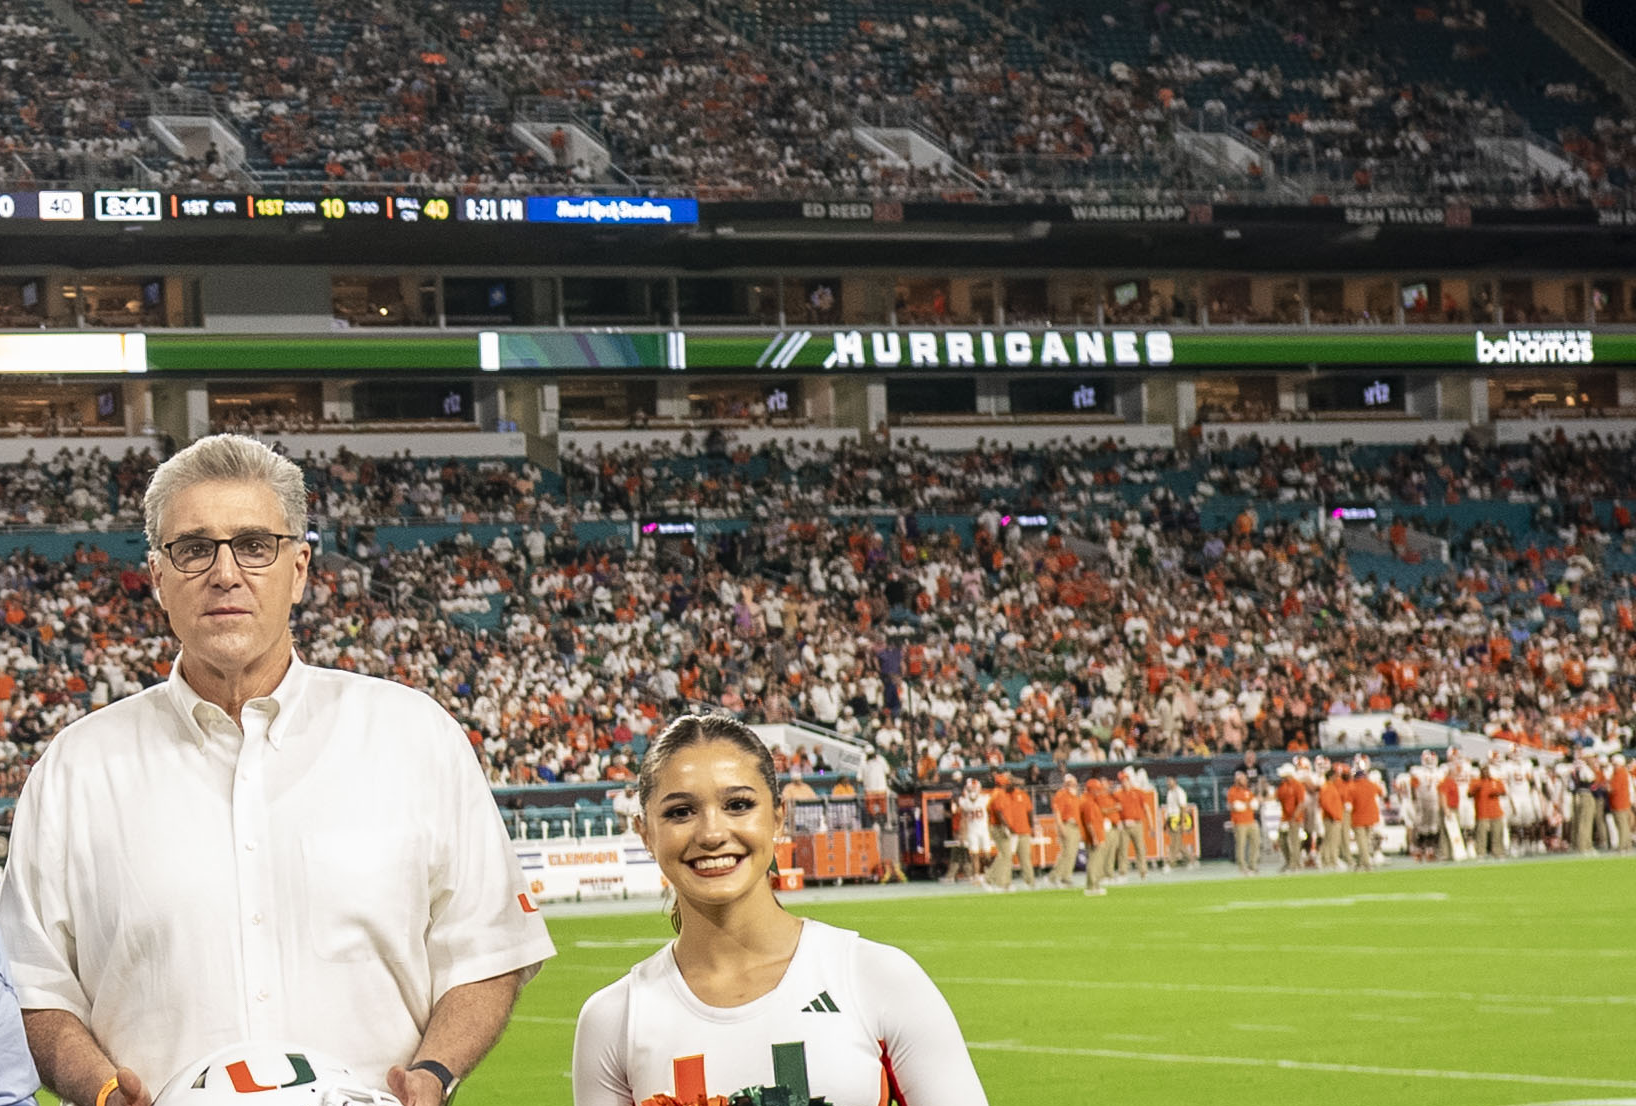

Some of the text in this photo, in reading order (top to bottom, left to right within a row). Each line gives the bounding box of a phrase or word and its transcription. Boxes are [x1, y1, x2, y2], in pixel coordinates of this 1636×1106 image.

[49, 198, 72, 214] 40
[105, 196, 151, 216] 8:44
[182, 199, 209, 216] 1ST
[256, 199, 285, 216] 1ST
[320, 198, 345, 219] 10
[423, 199, 449, 220] 40
[466, 198, 524, 221] 8:21 PM
[802, 202, 826, 219] ED
[829, 203, 872, 219] REED
[1071, 205, 1141, 221] WARREN
[1344, 208, 1385, 225] SEAN
[1388, 208, 1445, 225] TAYLOR
[823, 330, 1175, 367] HURRICANES
[1475, 330, 1595, 364] bahamas
